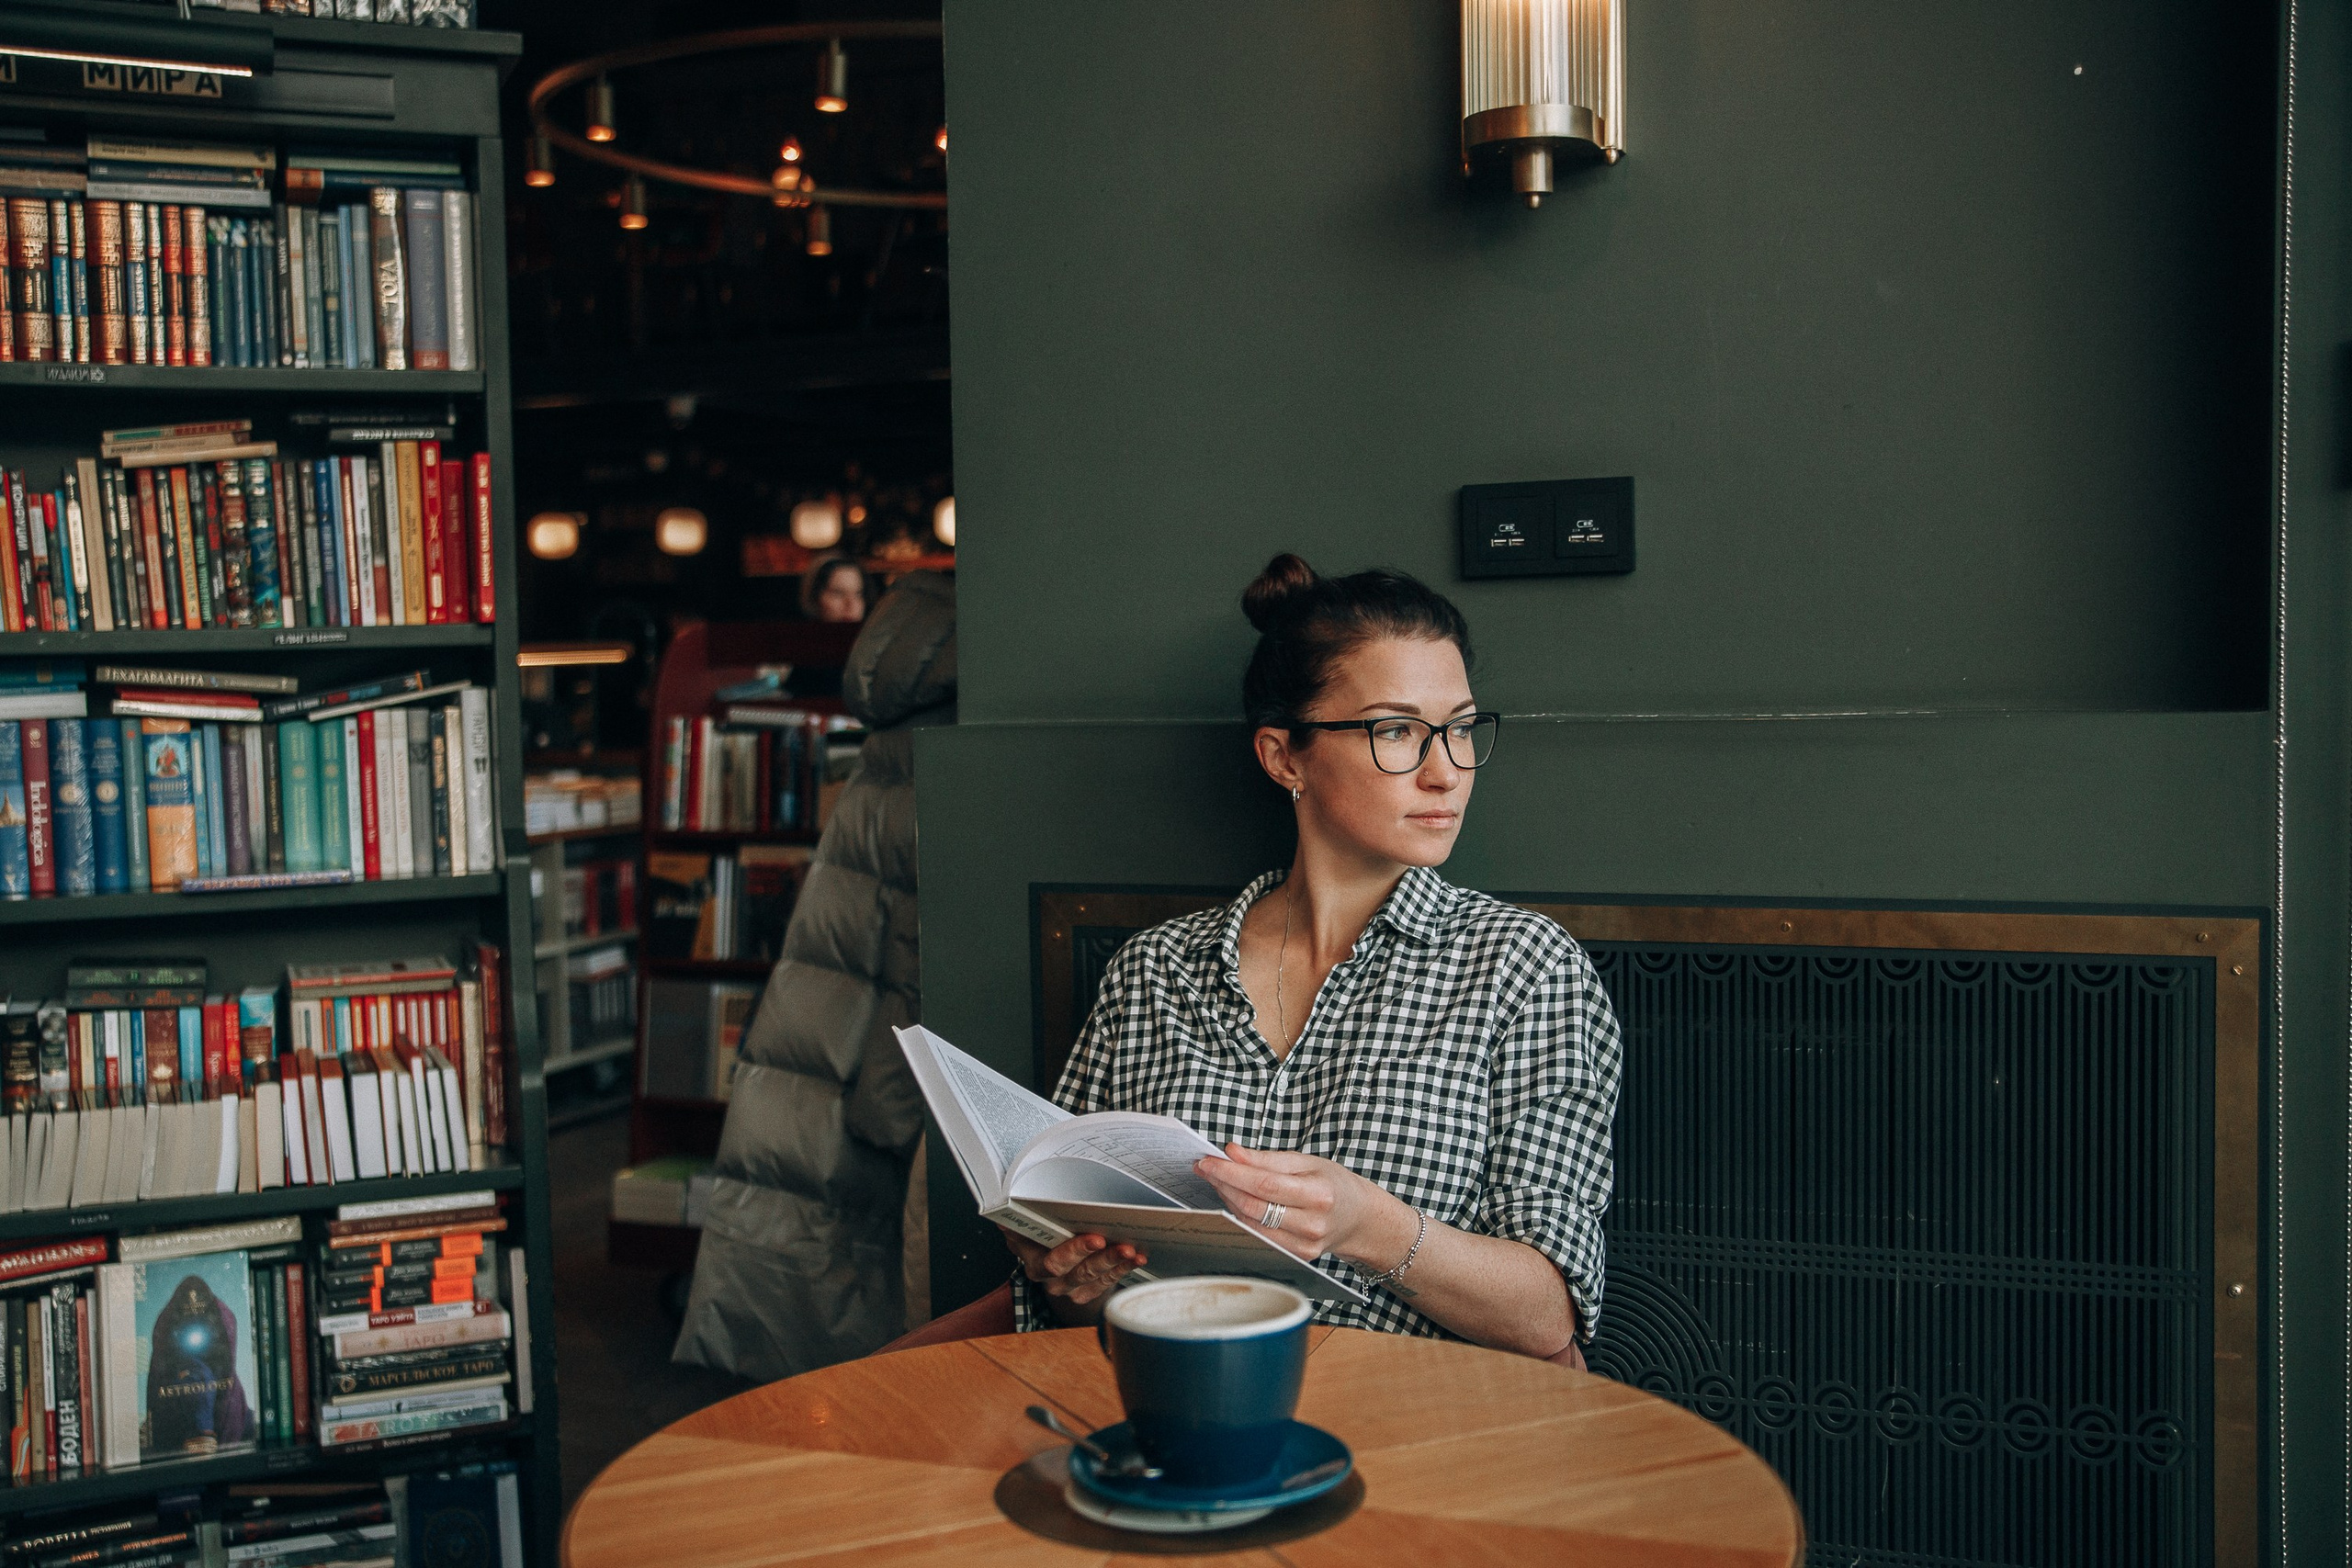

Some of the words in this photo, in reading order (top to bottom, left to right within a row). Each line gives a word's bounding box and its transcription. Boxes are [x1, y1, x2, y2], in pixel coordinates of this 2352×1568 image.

[89, 65, 221, 96] МИРА
[381, 258, 398, 305] ТОРА
[30, 780, 47, 866] Indologica
[371, 1314, 390, 1325] ТАРО
[390, 1313, 414, 1324] УЭЙТА
[368, 1366, 457, 1386] МАРСЕЛЬСКОЕ
[464, 1360, 494, 1374] ТАРО
[158, 1378, 234, 1398] ASTROLOGY
[357, 1416, 428, 1439] TAROT
[70, 1551, 100, 1563] JAMES
